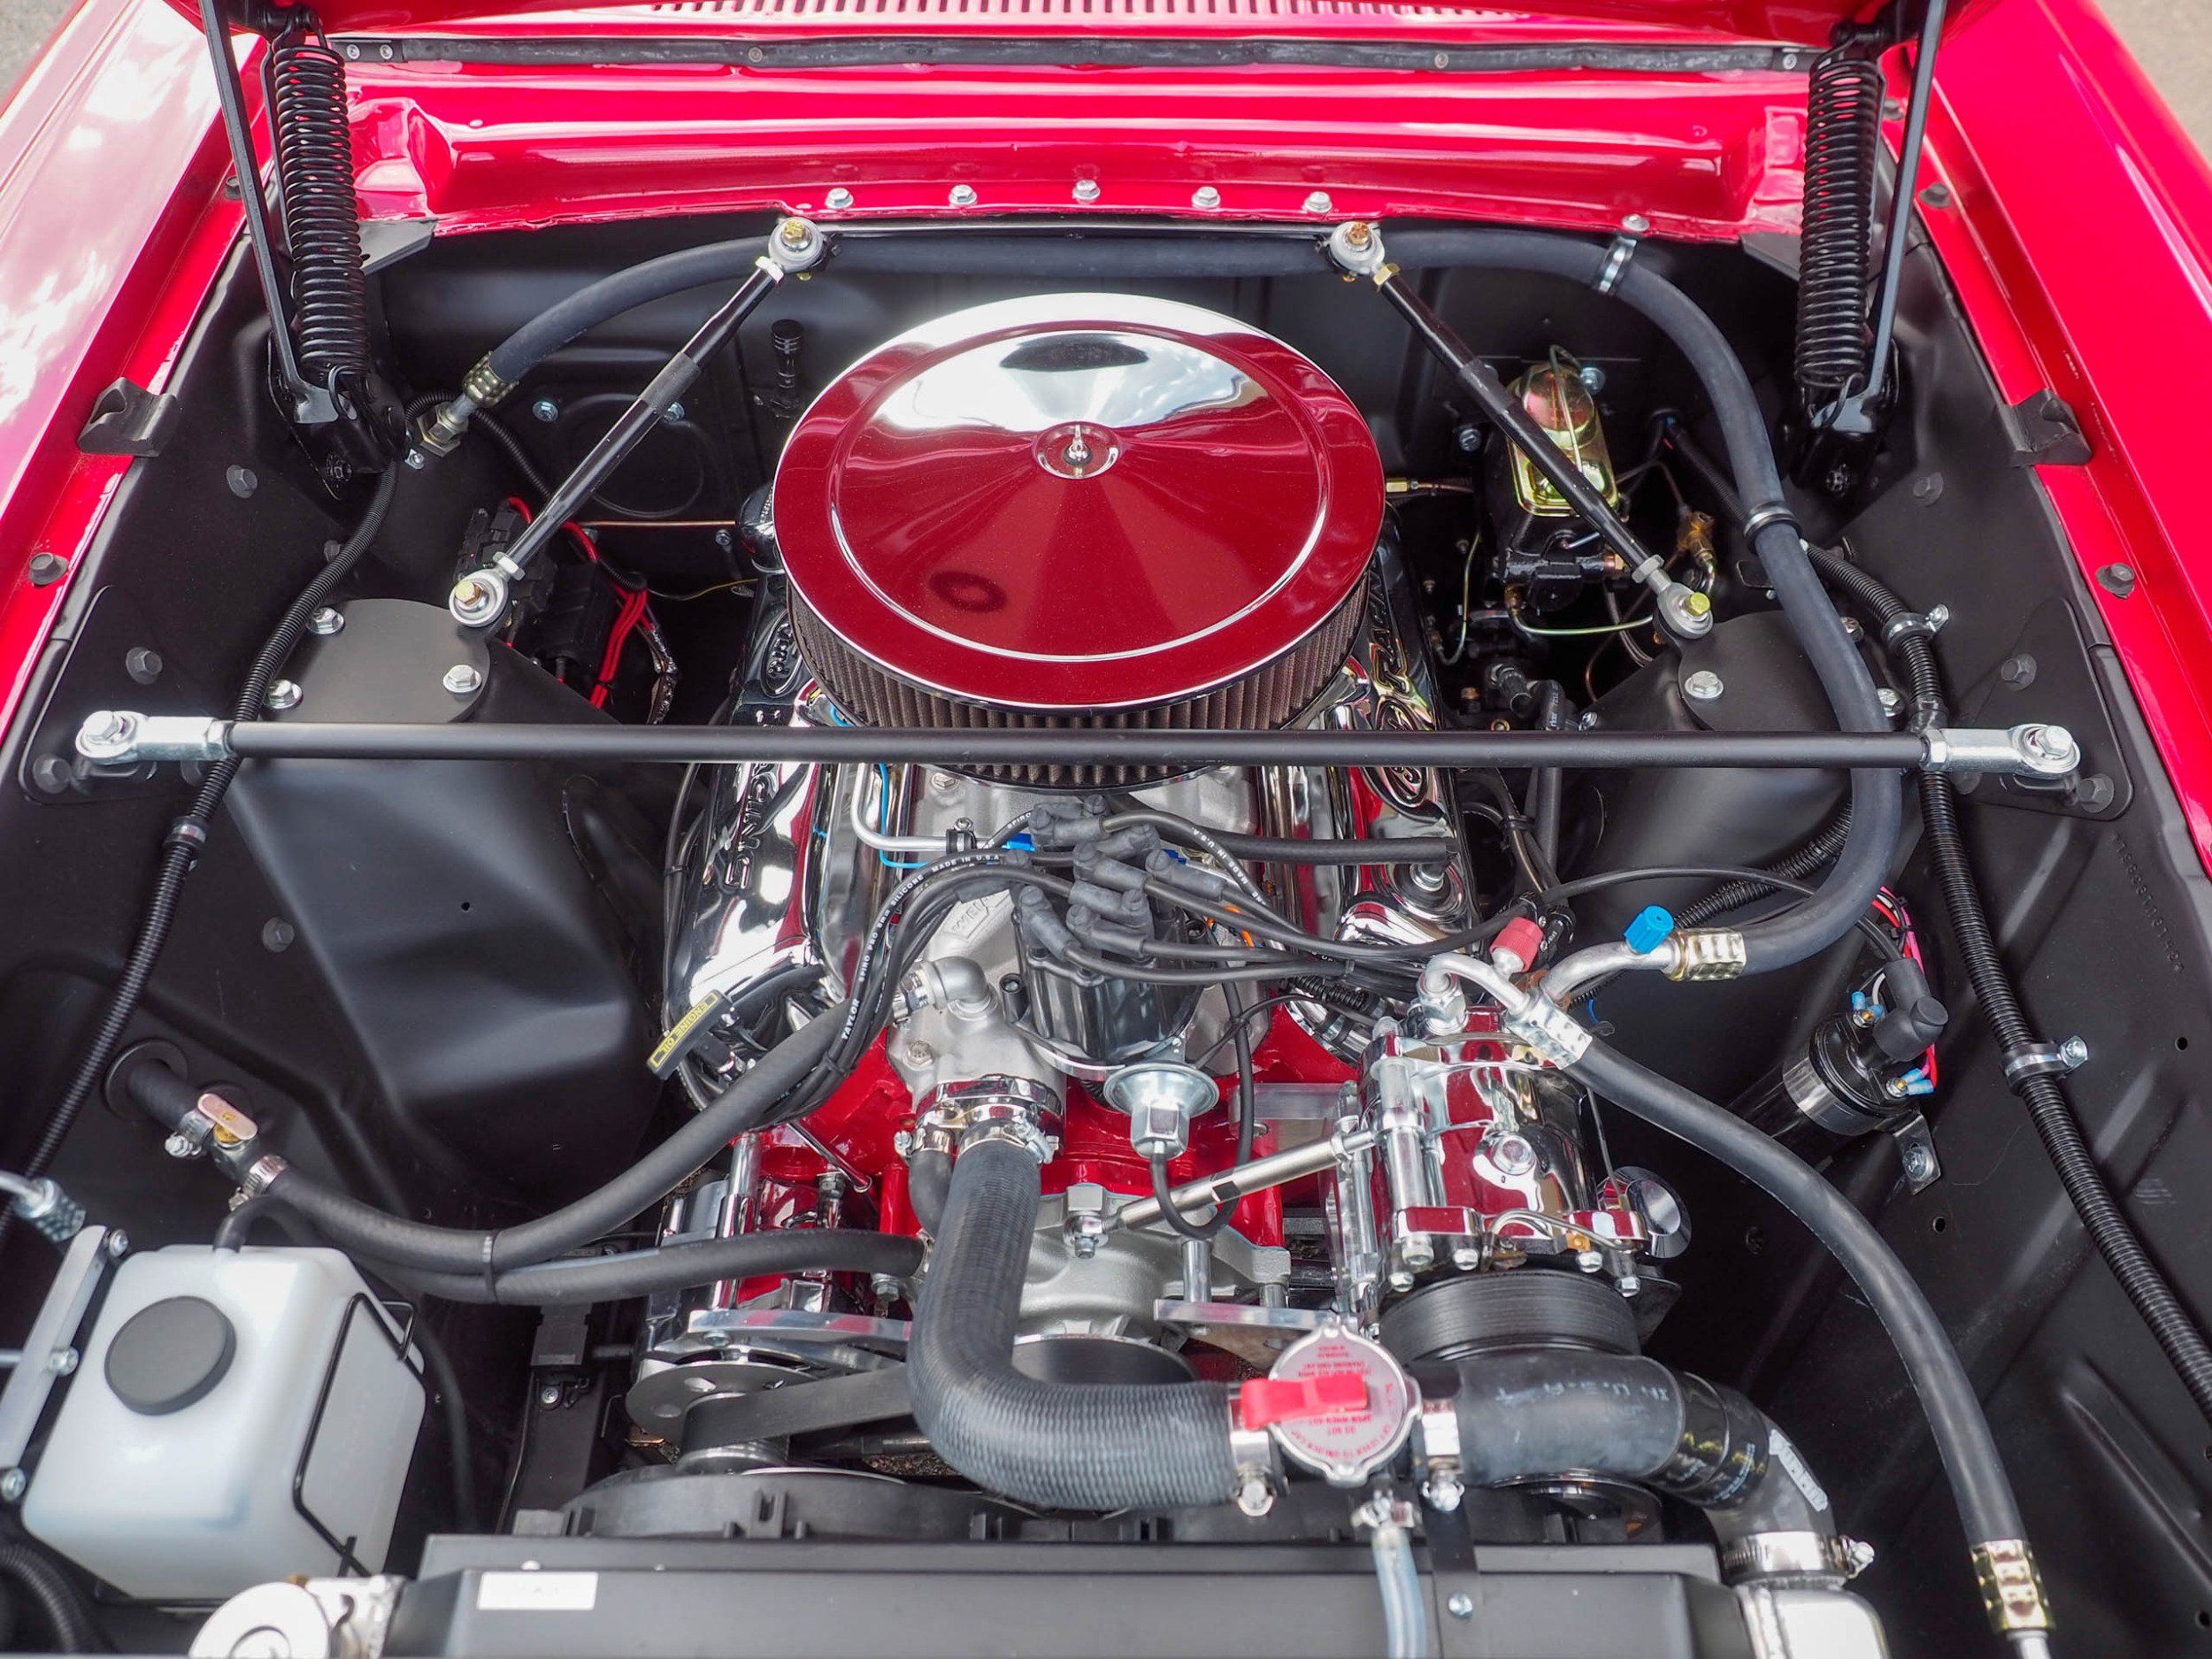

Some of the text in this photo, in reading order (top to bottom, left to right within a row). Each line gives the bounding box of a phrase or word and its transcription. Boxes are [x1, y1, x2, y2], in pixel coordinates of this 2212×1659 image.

[1217, 849, 1227, 859] IN
[1228, 861, 1249, 885] MADE
[841, 997, 861, 1041] TAYLOR
[859, 954, 871, 982] SPIRO
[867, 932, 879, 951] PRO
[890, 873, 925, 908] SILICONE
[931, 858, 957, 872] MADE
[660, 1002, 709, 1054] ENGINE OIL
